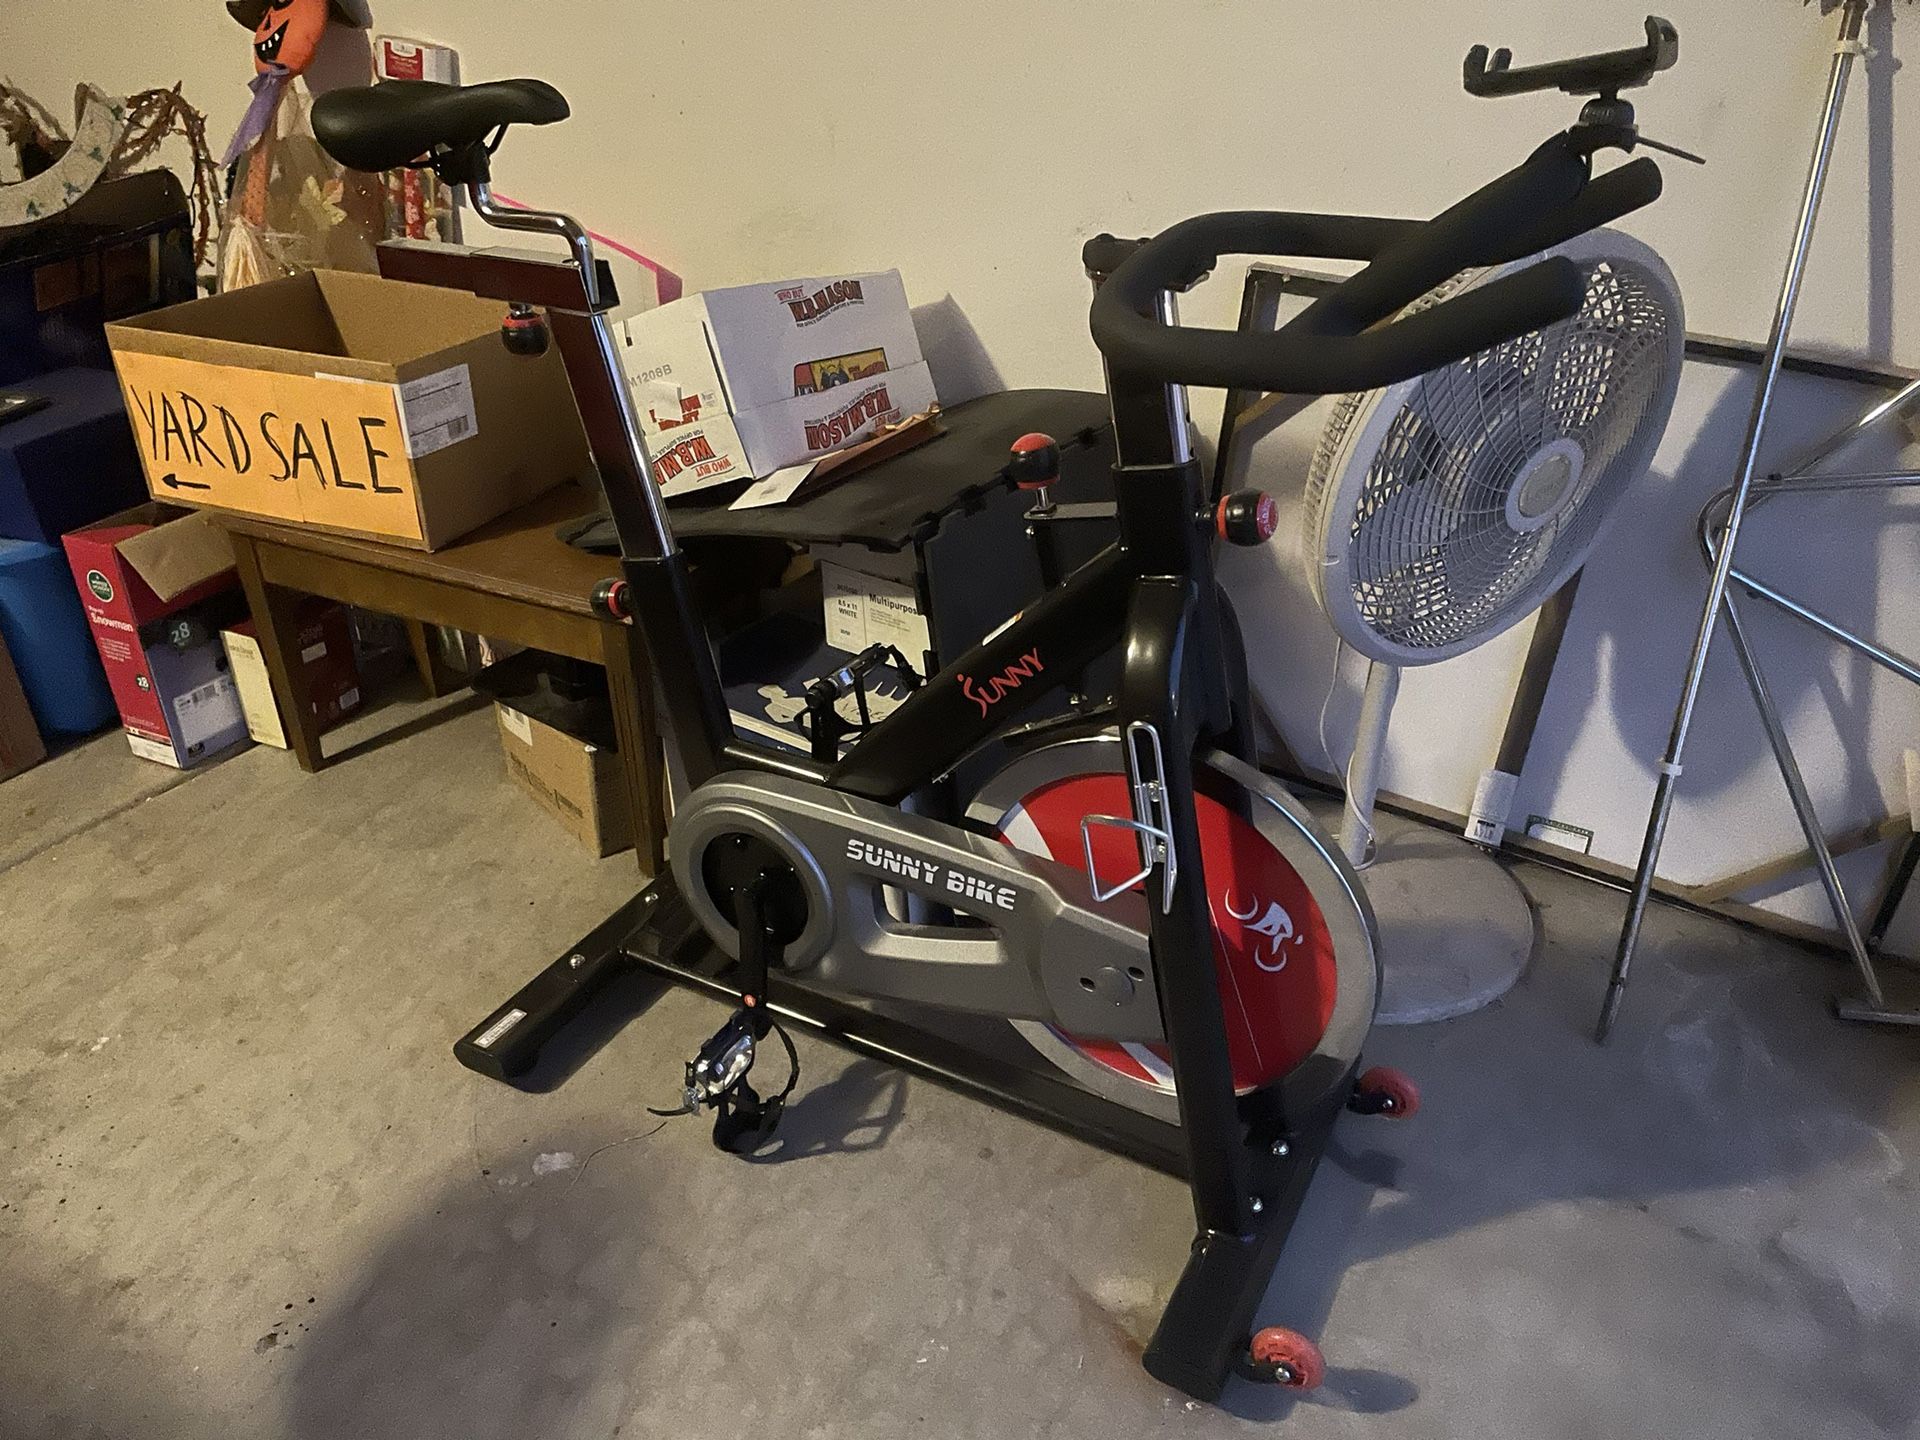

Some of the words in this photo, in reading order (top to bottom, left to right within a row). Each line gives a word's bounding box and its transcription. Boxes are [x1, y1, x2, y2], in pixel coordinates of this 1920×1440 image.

[129, 384, 251, 474] YARD
[260, 412, 403, 494] SALE
[695, 464, 712, 477] BUT
[712, 457, 732, 472] WHO
[90, 612, 134, 632] Snowman
[838, 607, 858, 619] WHITE
[171, 622, 191, 643] 28
[136, 675, 150, 689] 28
[957, 647, 1044, 719] SUNNY
[846, 839, 940, 885] SUNNY
[946, 870, 1017, 911] BIKE
